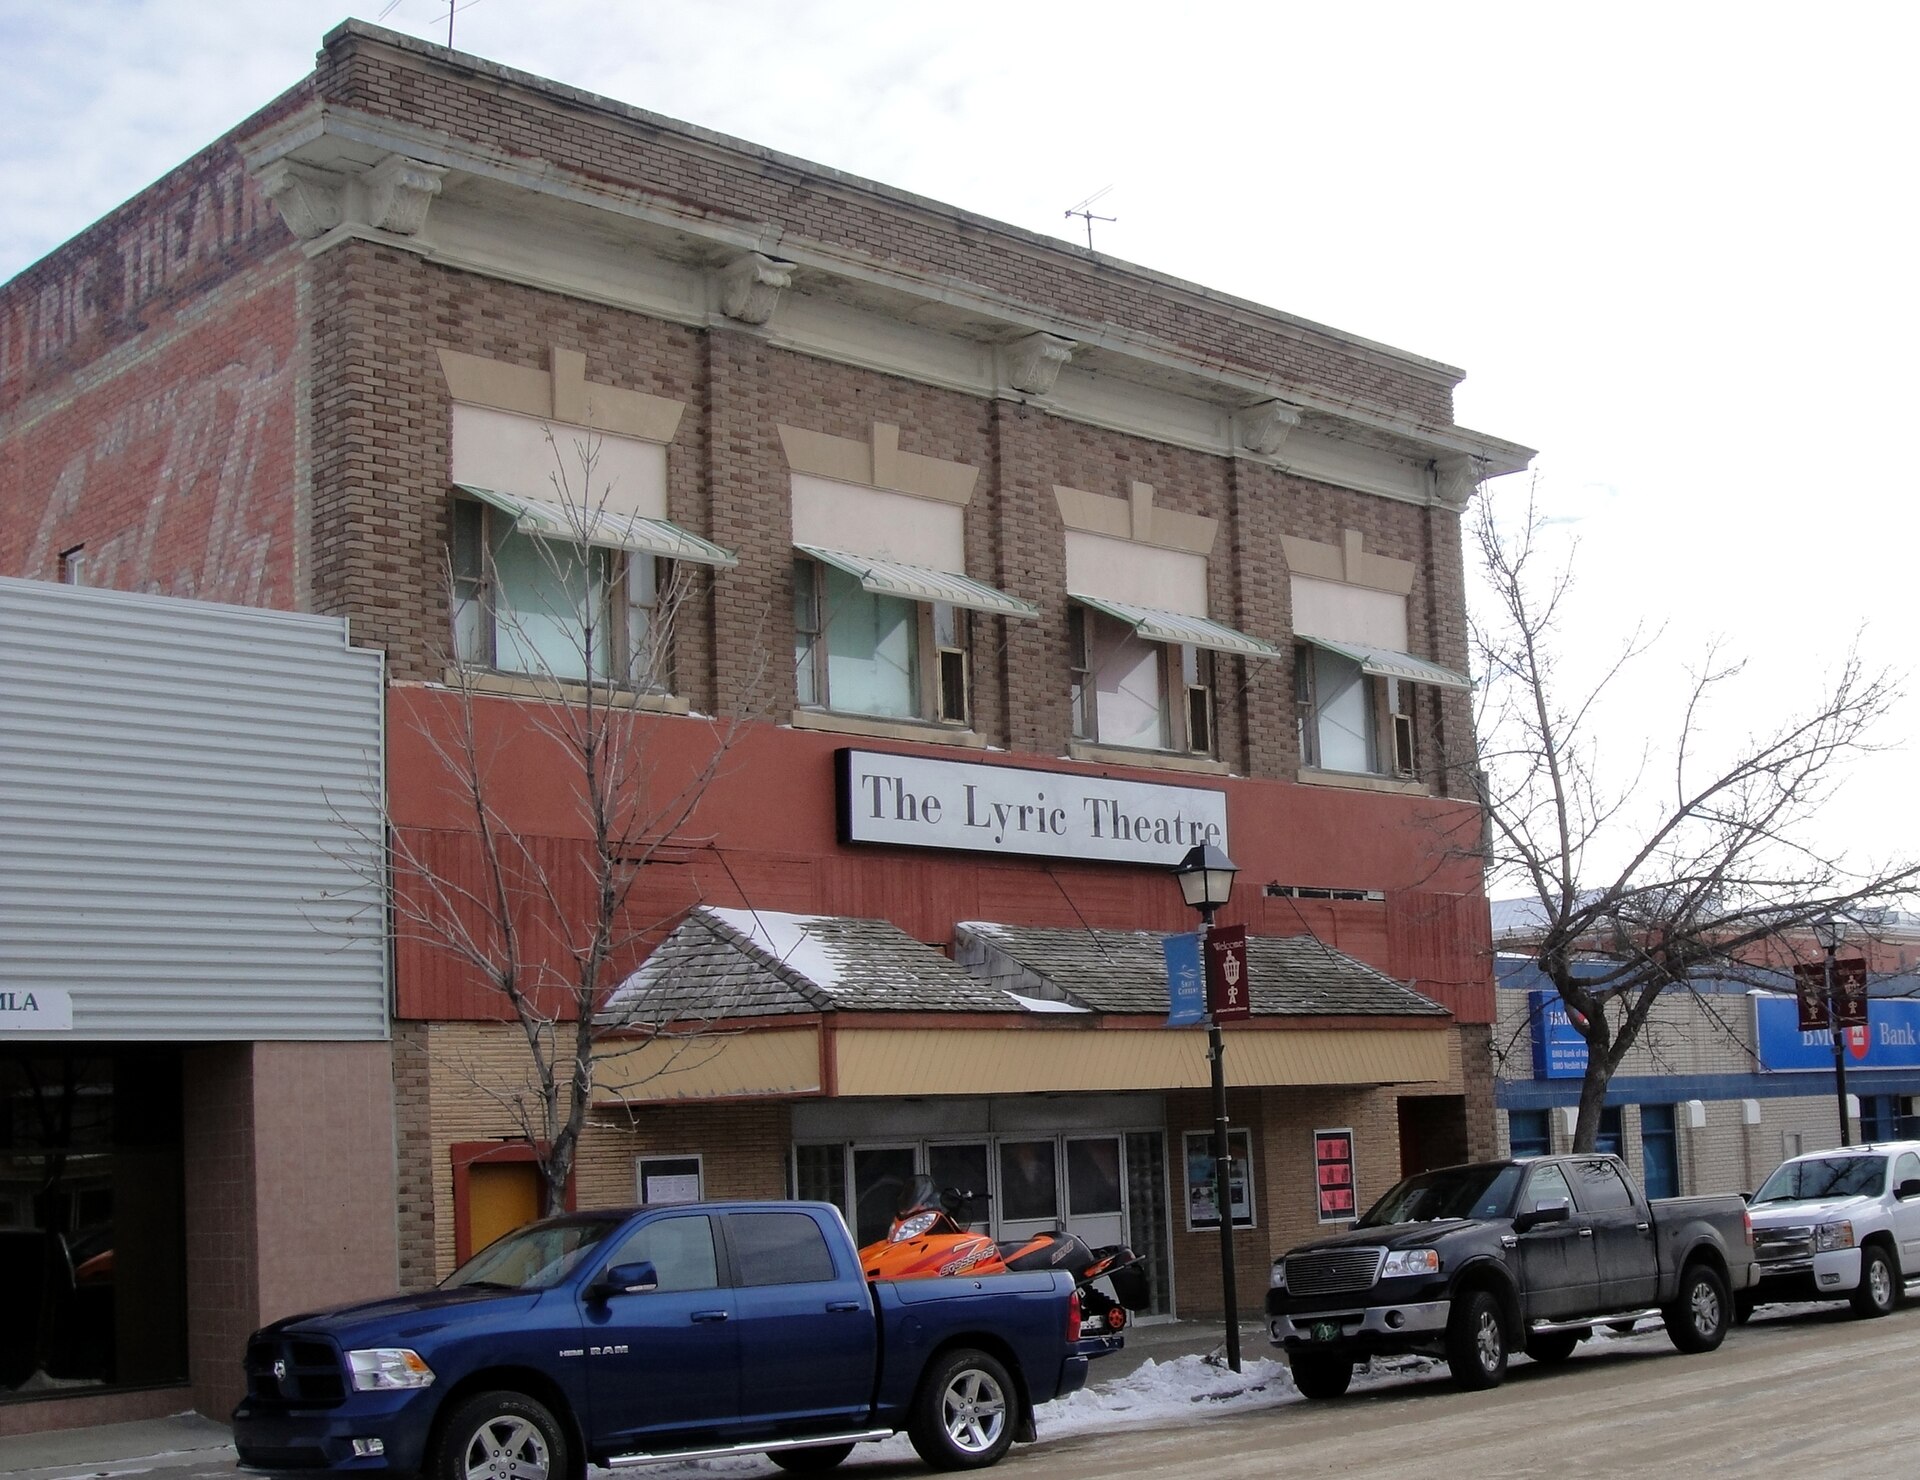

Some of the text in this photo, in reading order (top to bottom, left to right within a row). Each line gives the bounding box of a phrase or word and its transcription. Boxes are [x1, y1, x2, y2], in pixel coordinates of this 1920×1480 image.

[862, 774, 1221, 848] The Lyric Theatre
[1213, 941, 1244, 951] Welcome
[1550, 1011, 1572, 1025] BM
[1879, 1021, 1917, 1046] Bank
[590, 1345, 629, 1355] RAM
